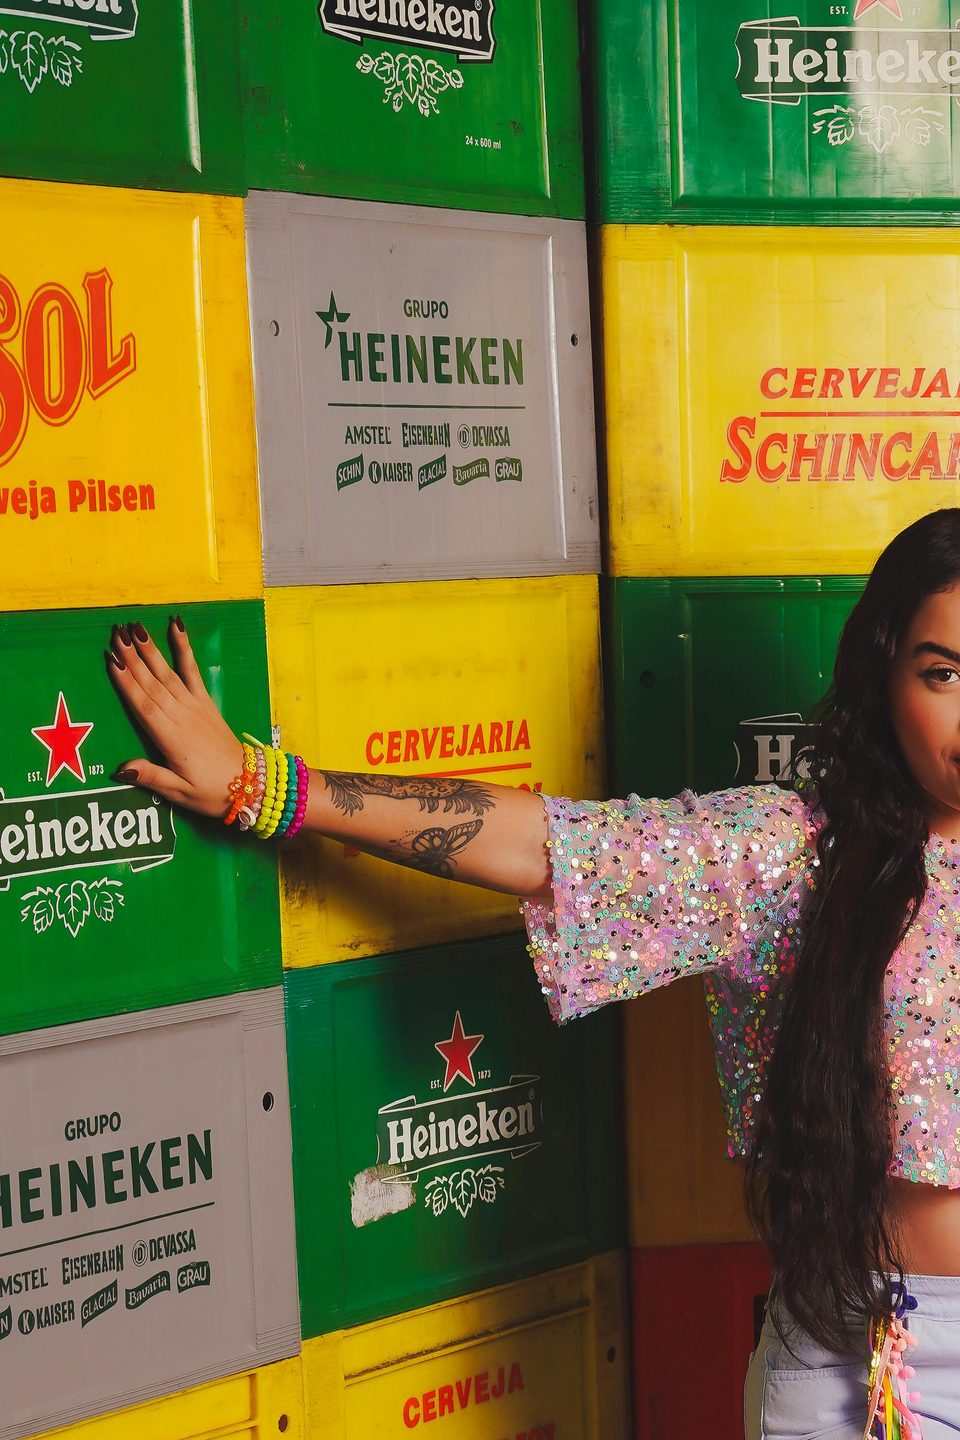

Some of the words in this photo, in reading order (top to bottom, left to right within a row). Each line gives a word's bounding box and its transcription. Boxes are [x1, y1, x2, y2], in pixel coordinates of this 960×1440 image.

[830, 6, 849, 15] EST.
[465, 136, 473, 145] 24
[480, 137, 492, 148] 600
[493, 139, 502, 149] ml
[403, 299, 449, 319] GRUPO
[338, 331, 524, 385] HEINEKEN
[345, 425, 391, 445] AMSTEL
[401, 423, 450, 447] EISENBAHN
[472, 426, 510, 447] DEVASSA
[337, 459, 362, 484] SCHIN
[383, 462, 413, 482] KAISER
[418, 460, 447, 485] GLACIAL
[455, 462, 488, 481] Bavaria
[496, 462, 520, 477] GRAU
[68, 479, 155, 513] Pilsen
[365, 719, 531, 766] CERVEJARIA
[27, 771, 43, 782] EST.
[88, 764, 105, 776] 1873
[0, 802, 163, 865] eineken
[430, 1079, 442, 1089] EST.
[477, 1070, 491, 1080] 1873
[64, 1111, 122, 1141] GRUPO
[386, 1101, 535, 1165] Heineken
[62, 1244, 124, 1285] EISENBAHN
[149, 1229, 197, 1261] DEVASSA
[36, 1300, 75, 1329] KAISER
[82, 1289, 117, 1320] GLACIAL
[128, 1275, 168, 1306] Bavaria
[178, 1268, 207, 1288] GRAU
[403, 1362, 525, 1428] CERVEJA
